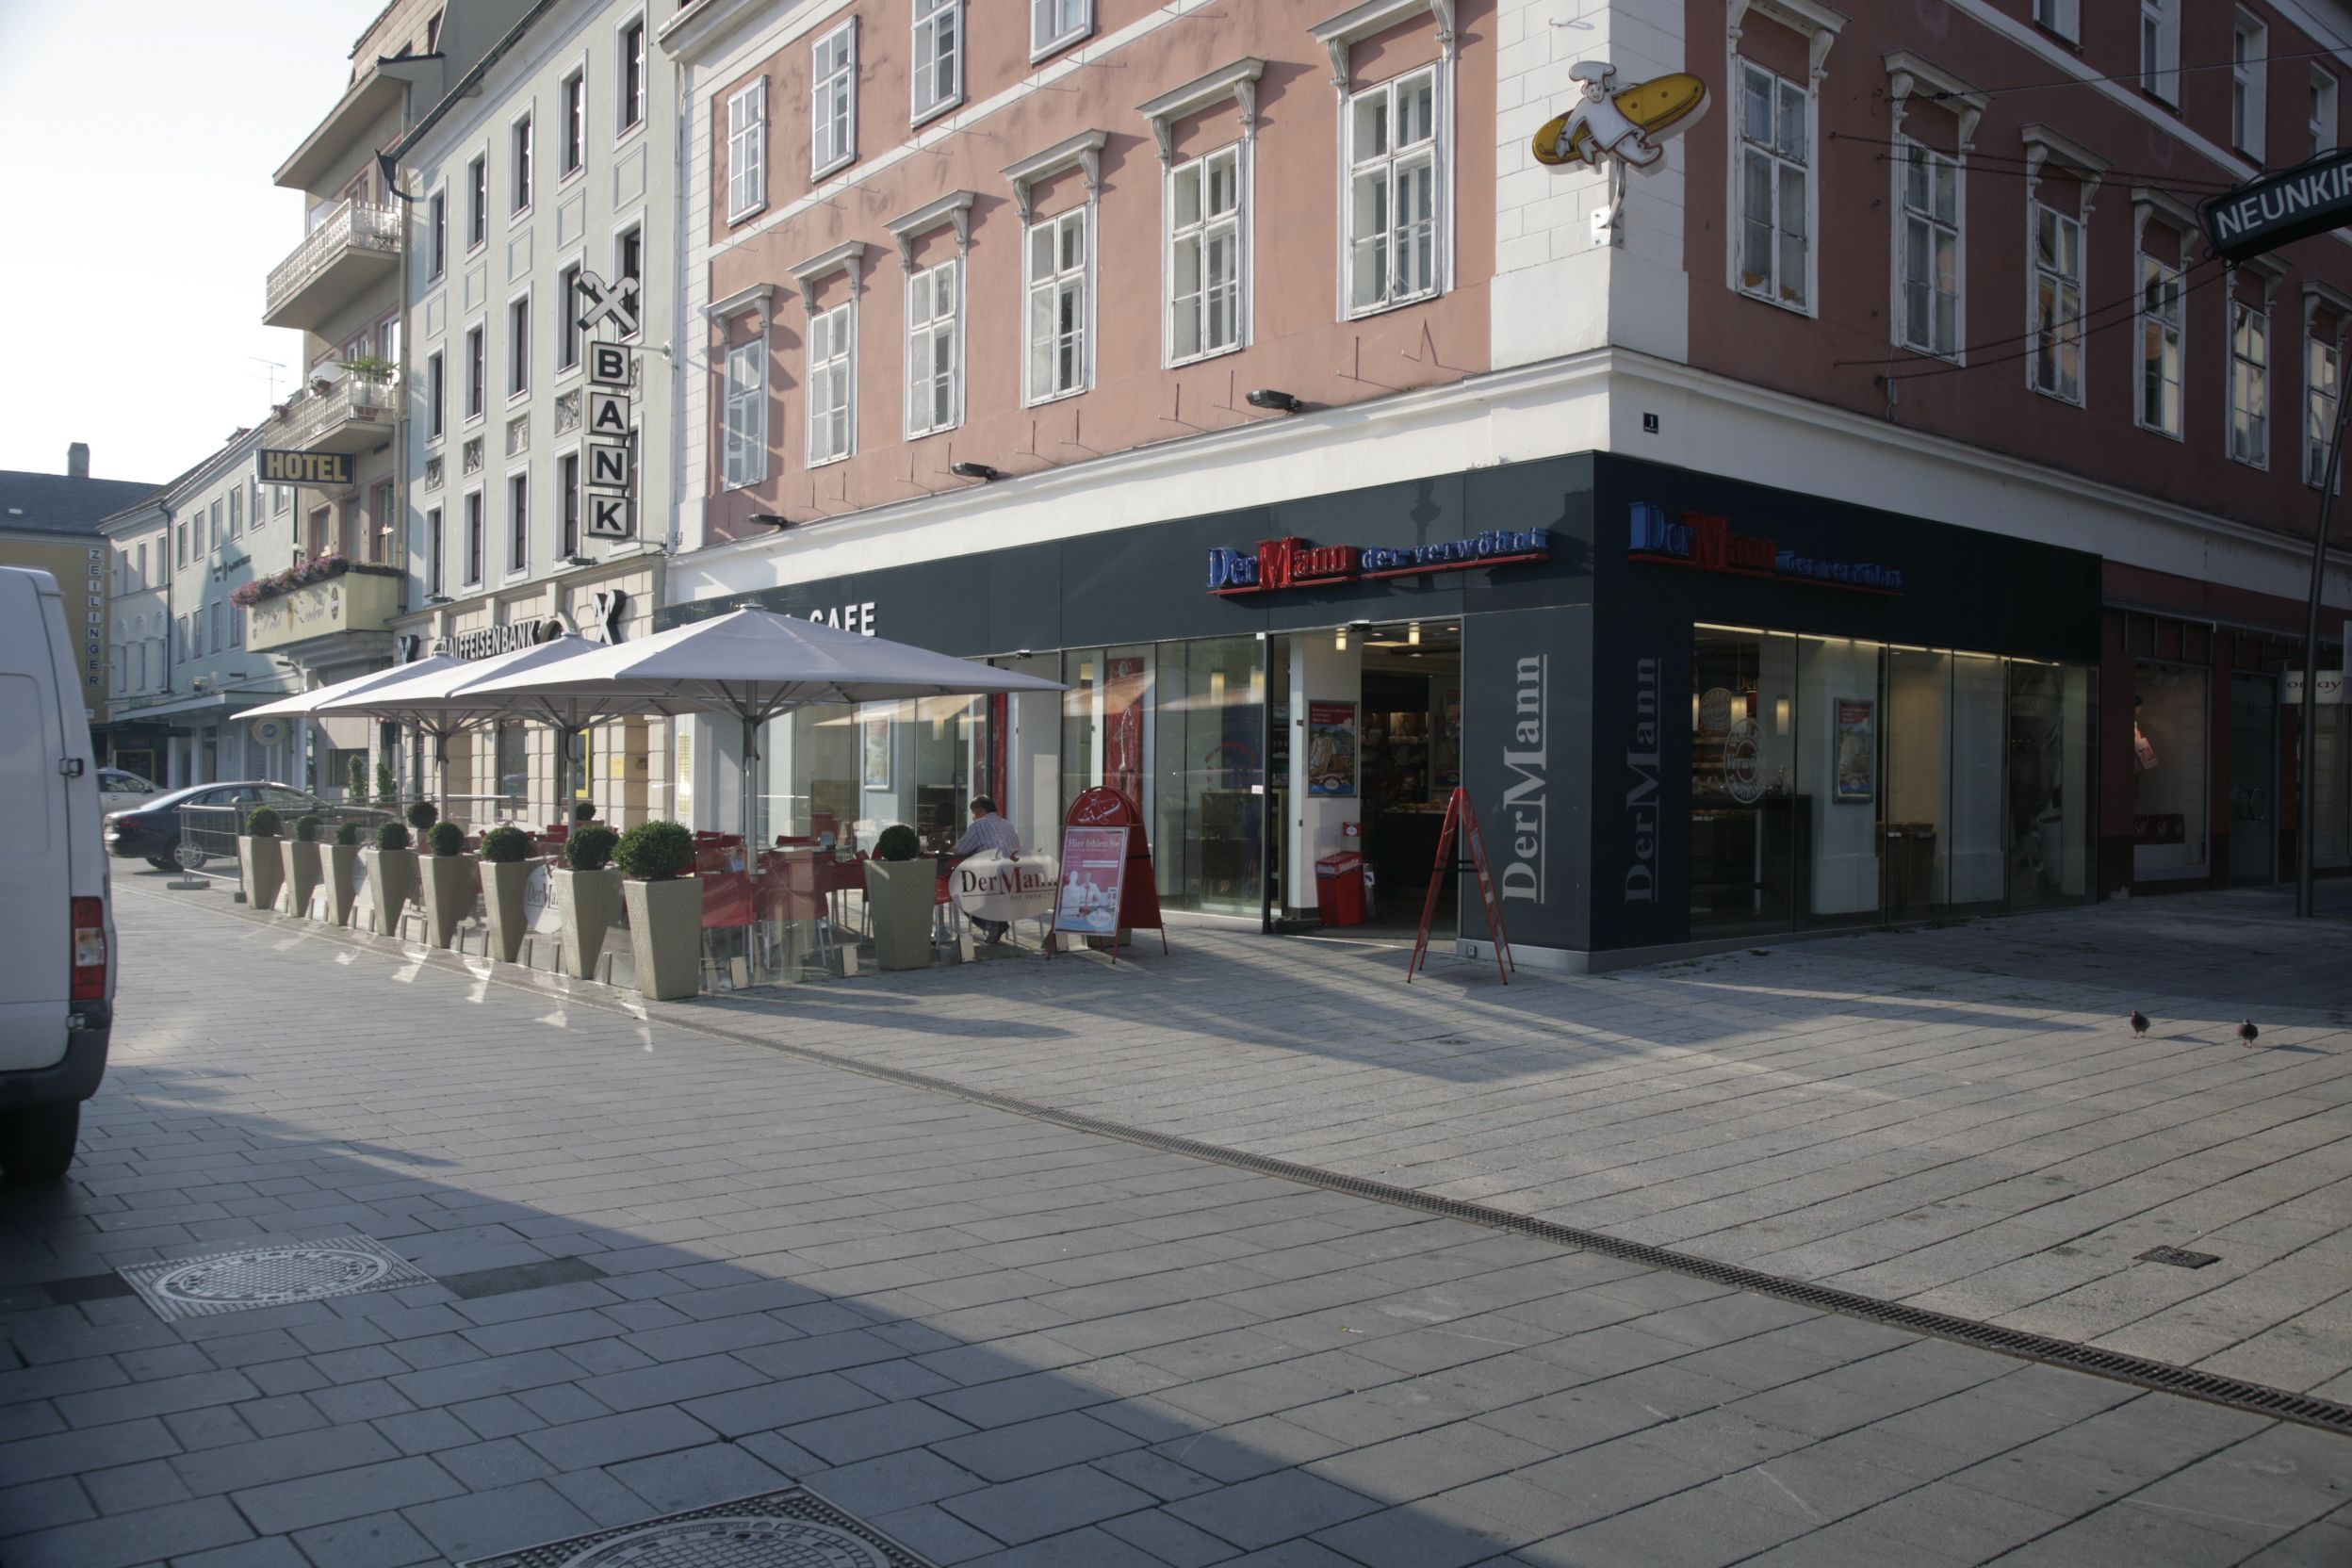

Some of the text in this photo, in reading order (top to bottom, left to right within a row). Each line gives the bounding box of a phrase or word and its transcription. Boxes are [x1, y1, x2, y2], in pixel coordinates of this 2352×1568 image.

[267, 452, 347, 482] HOTEL
[596, 349, 624, 531] BANK
[1414, 528, 1549, 563] verwöhnt
[89, 549, 101, 686] ZEILINGER
